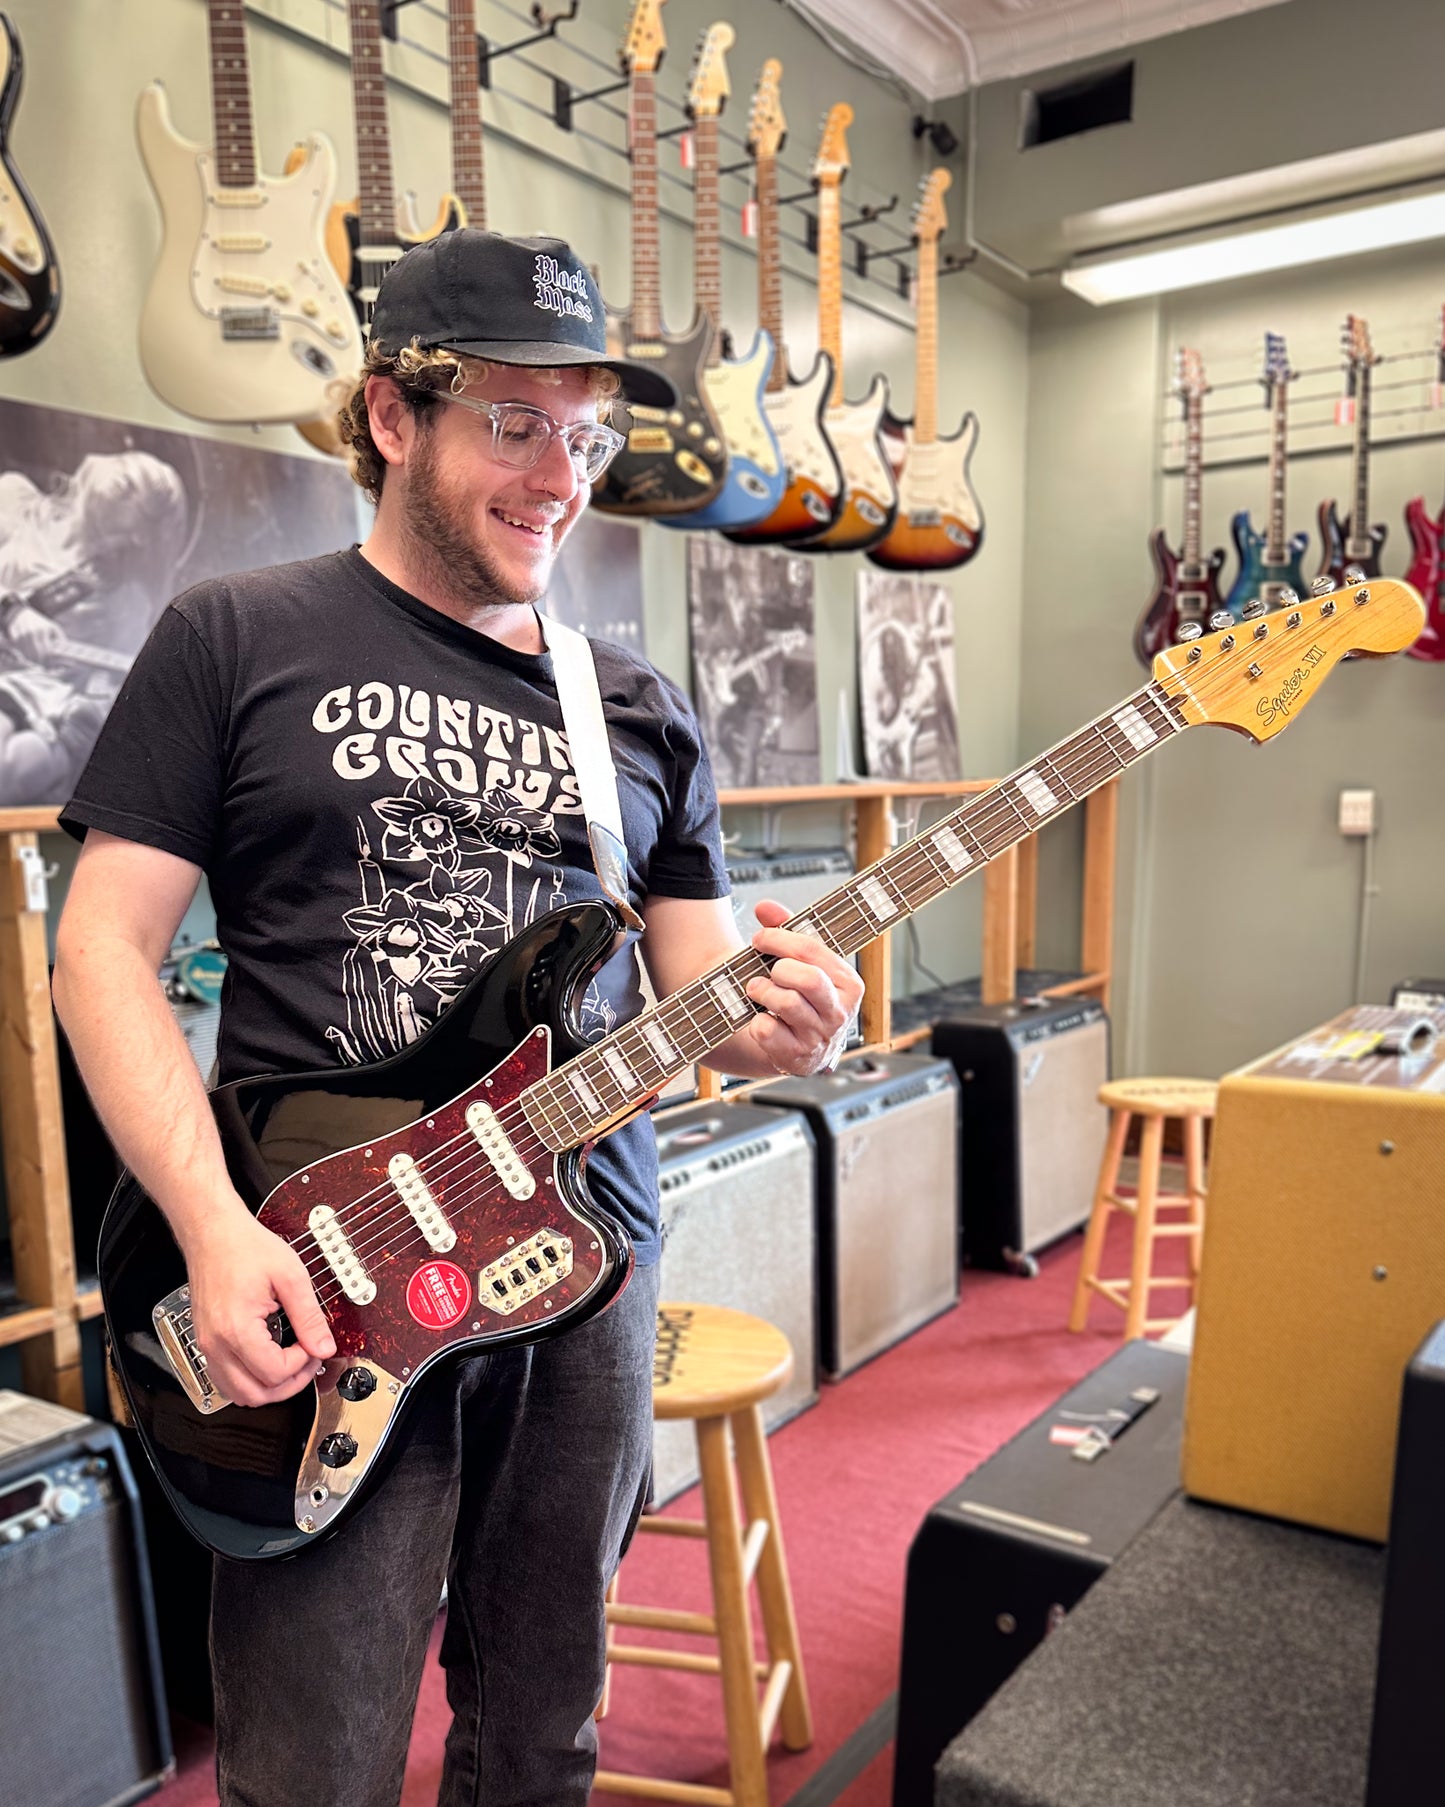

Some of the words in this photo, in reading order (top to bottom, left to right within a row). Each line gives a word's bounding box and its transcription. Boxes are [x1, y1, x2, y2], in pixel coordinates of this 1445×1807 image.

[532, 254, 589, 299] Black
[533, 283, 593, 322] Mass
[1256, 668, 1310, 726] Squier
[1302, 645, 1327, 668] VI
[312, 681, 574, 771] COUNTIN
[332, 733, 586, 815] CROWS
[425, 1267, 447, 1298] FREE
[446, 1272, 463, 1299] Fender
